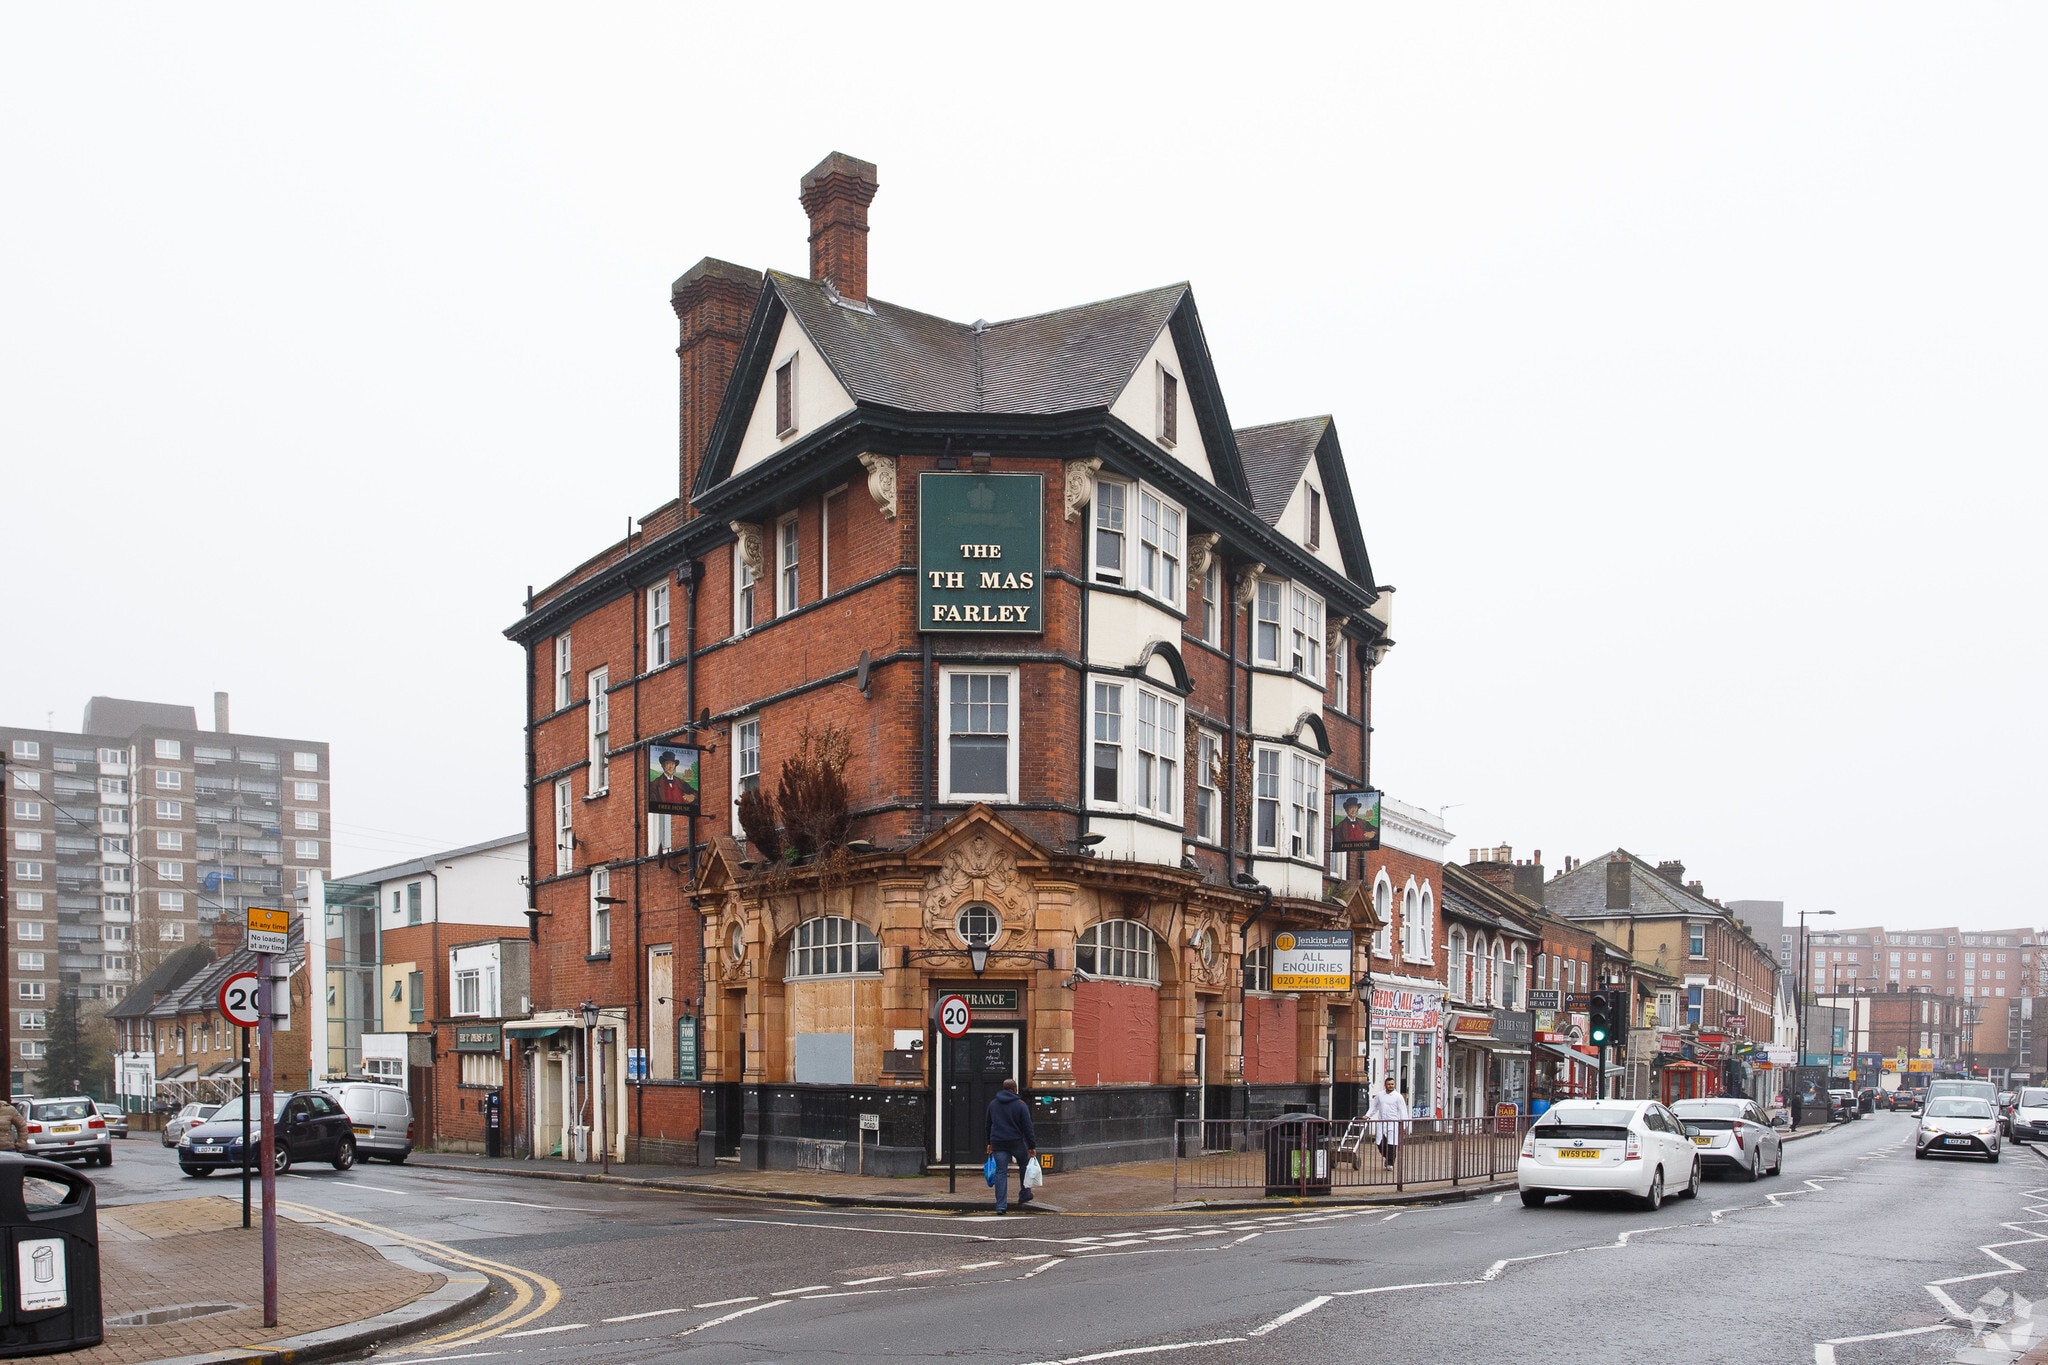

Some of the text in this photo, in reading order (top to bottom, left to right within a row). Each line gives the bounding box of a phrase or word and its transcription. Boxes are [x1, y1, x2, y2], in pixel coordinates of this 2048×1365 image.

[960, 544, 1001, 558] THE
[932, 604, 1030, 622] FARLEY
[262, 936, 285, 944] loading
[1298, 936, 1328, 946] Jenkins
[1303, 952, 1324, 962] ALL
[1282, 963, 1342, 973] ENQUIRIES
[960, 994, 1005, 1004] TRANCE
[1374, 989, 1394, 1008] BEDS
[1400, 992, 1413, 1010] ALL
[945, 1008, 966, 1024] 20
[682, 1027, 694, 1038] FOOD
